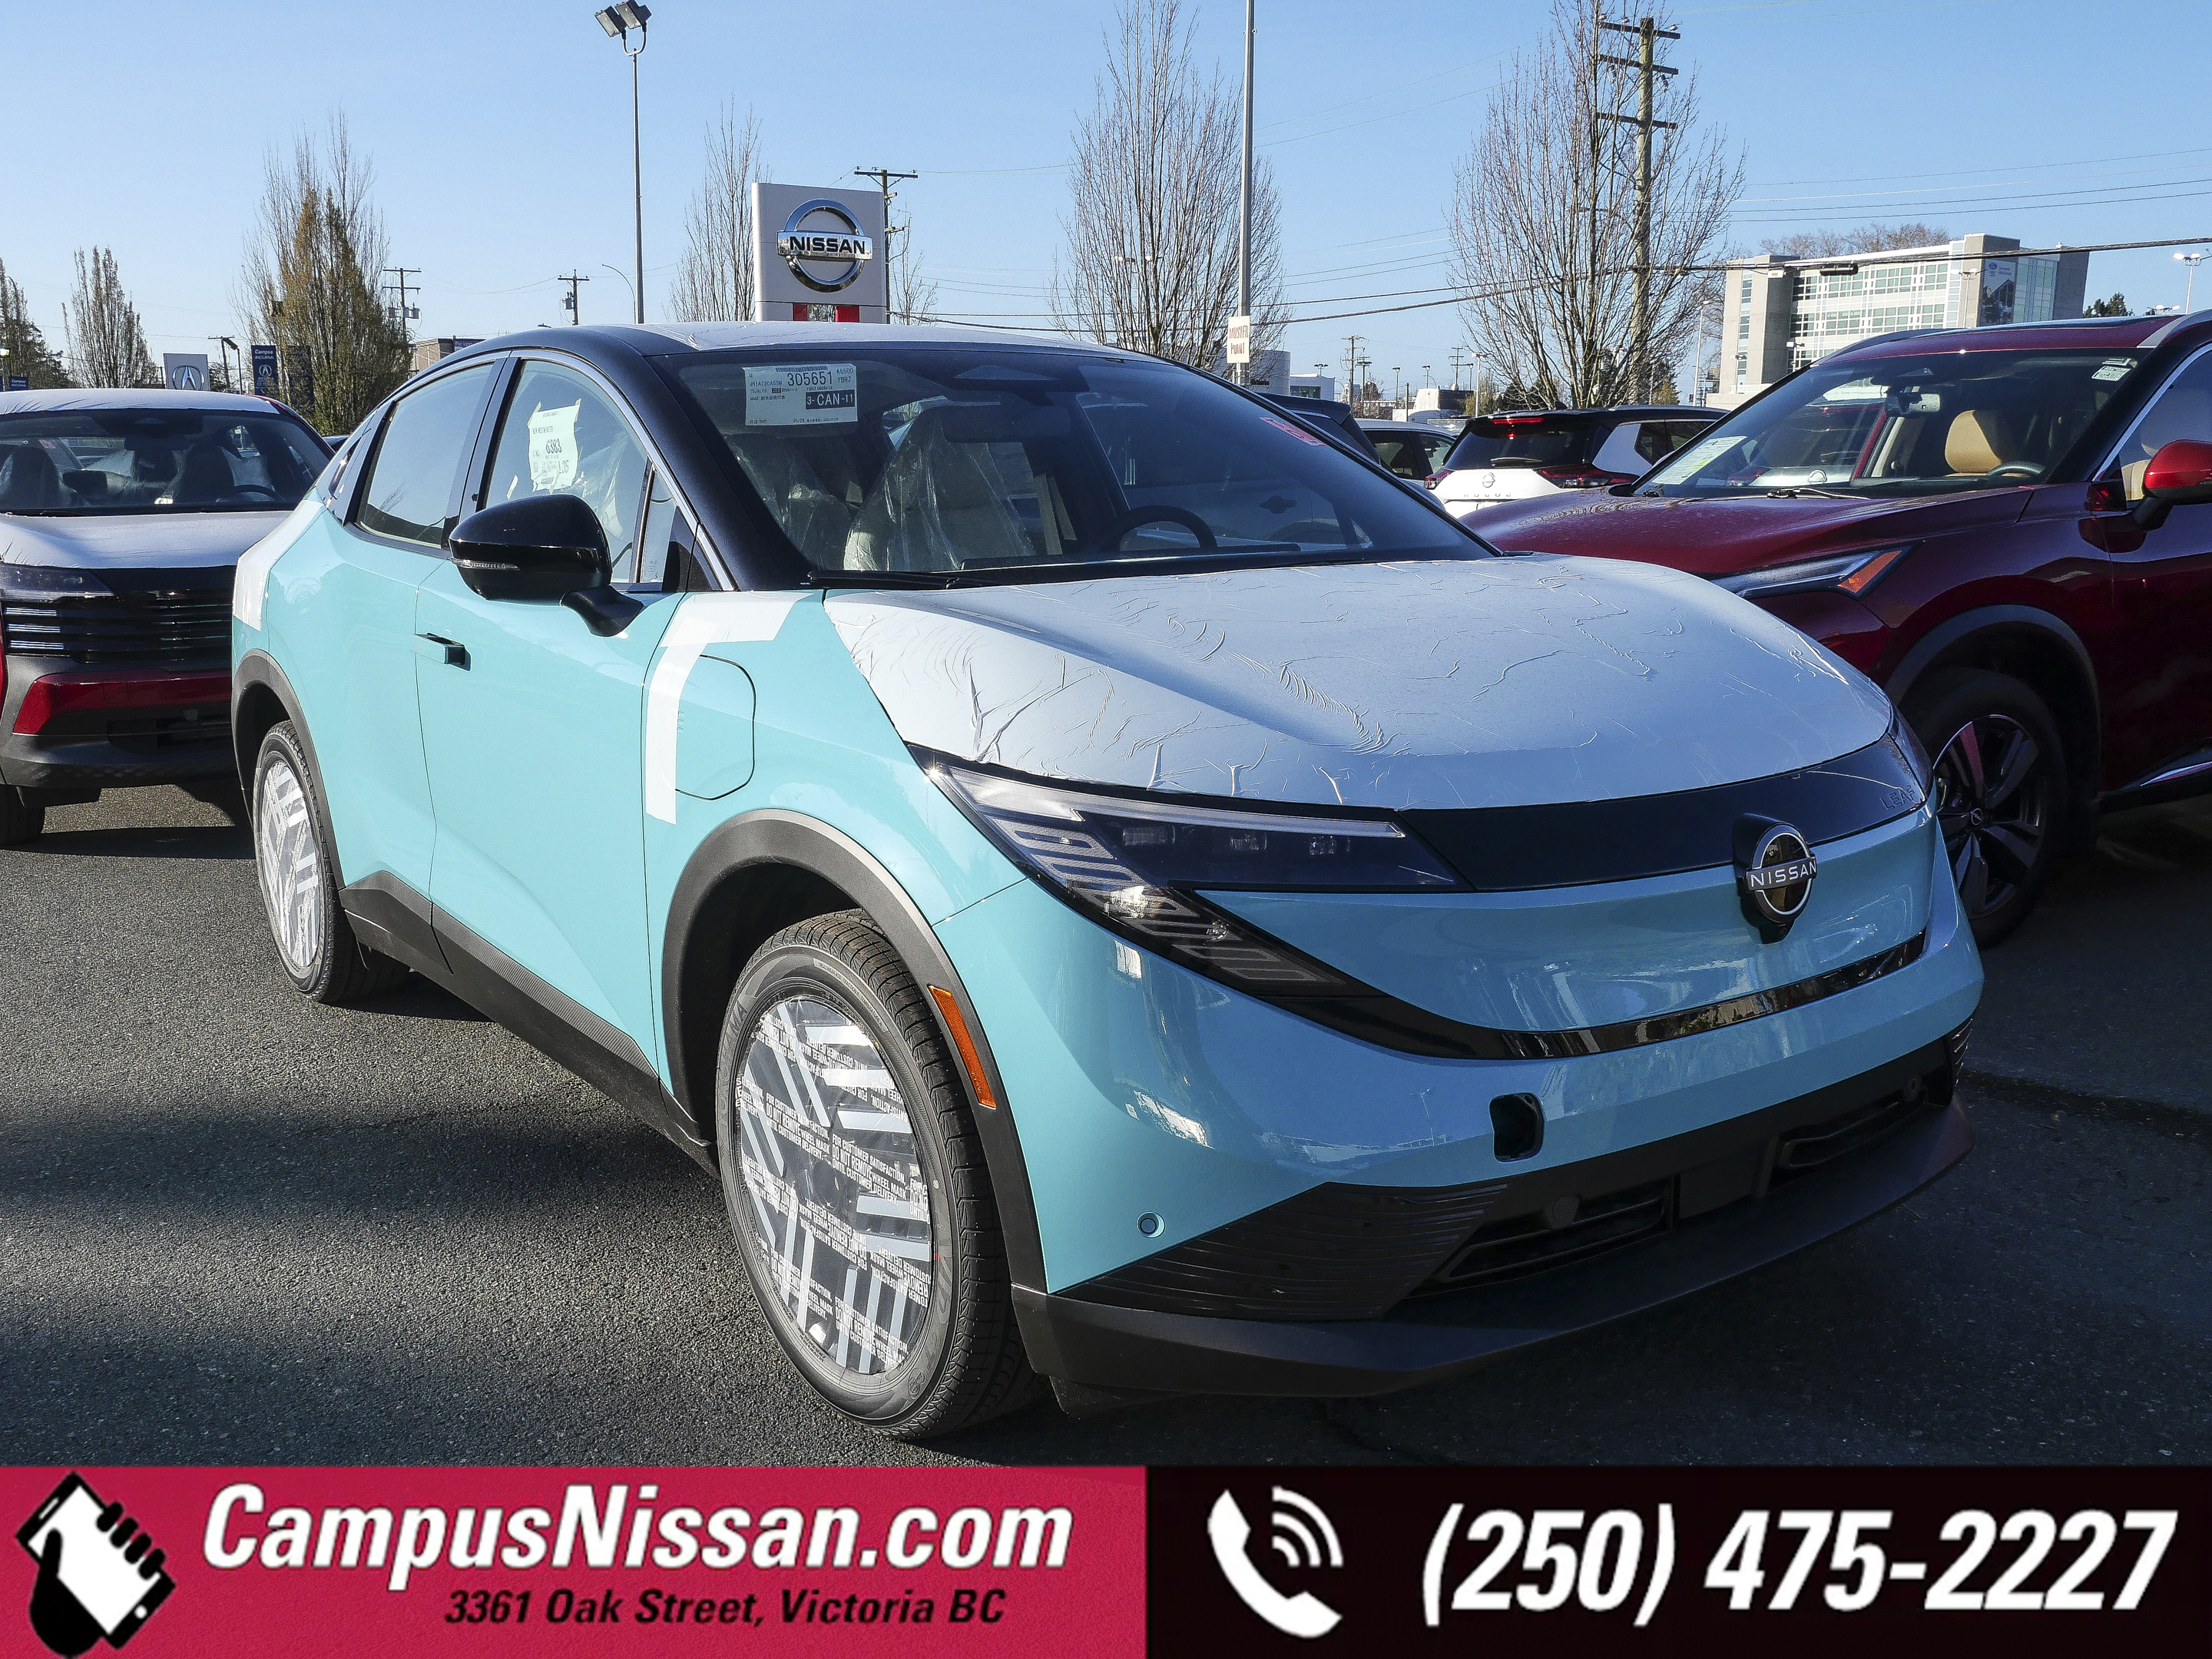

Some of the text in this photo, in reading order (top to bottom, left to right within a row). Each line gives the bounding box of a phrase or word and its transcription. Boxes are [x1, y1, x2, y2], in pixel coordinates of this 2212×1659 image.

[790, 236, 866, 254] NISSAN
[1229, 325, 1248, 339] MUSTER
[1230, 343, 1244, 354] POINT
[787, 371, 833, 386] 305651
[545, 438, 562, 454] 6383
[1879, 784, 1916, 810] LEAF
[1750, 860, 1816, 887] NISSAN
[832, 1133, 842, 1147] FOR
[843, 1138, 869, 1163] CUSTOMER
[832, 1144, 839, 1160] DO
[840, 1148, 850, 1167] NOT
[873, 1171, 890, 1190] WHEEL
[891, 1183, 906, 1200] MASK
